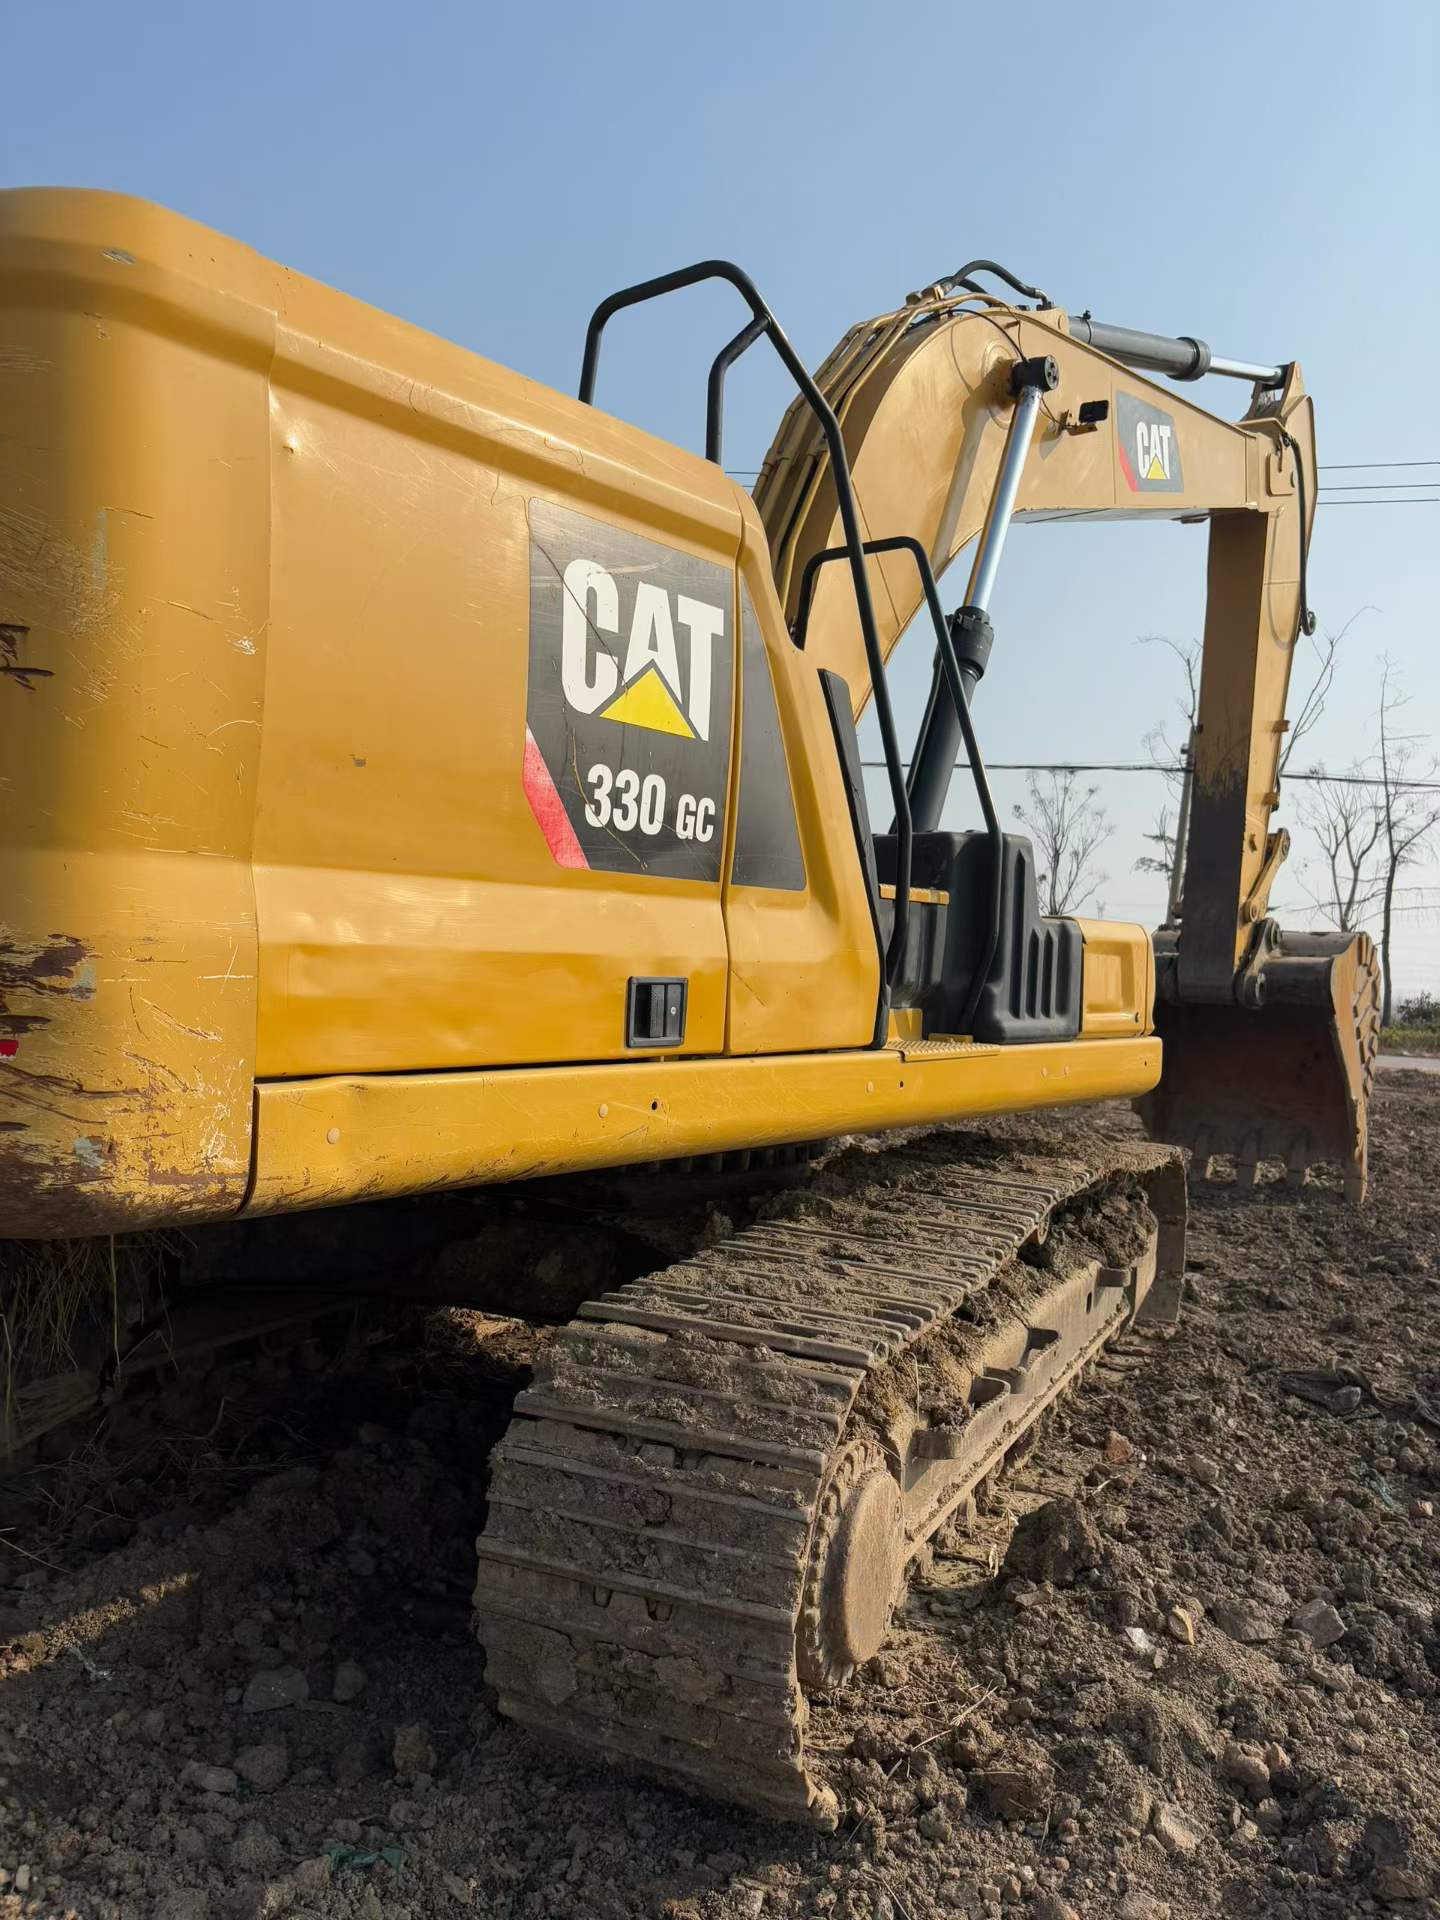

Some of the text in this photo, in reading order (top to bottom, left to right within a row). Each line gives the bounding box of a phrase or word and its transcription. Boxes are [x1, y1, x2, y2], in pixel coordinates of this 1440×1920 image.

[1136, 421, 1171, 480] CAT
[562, 558, 724, 741] CAT
[584, 764, 716, 843] 330 GC
